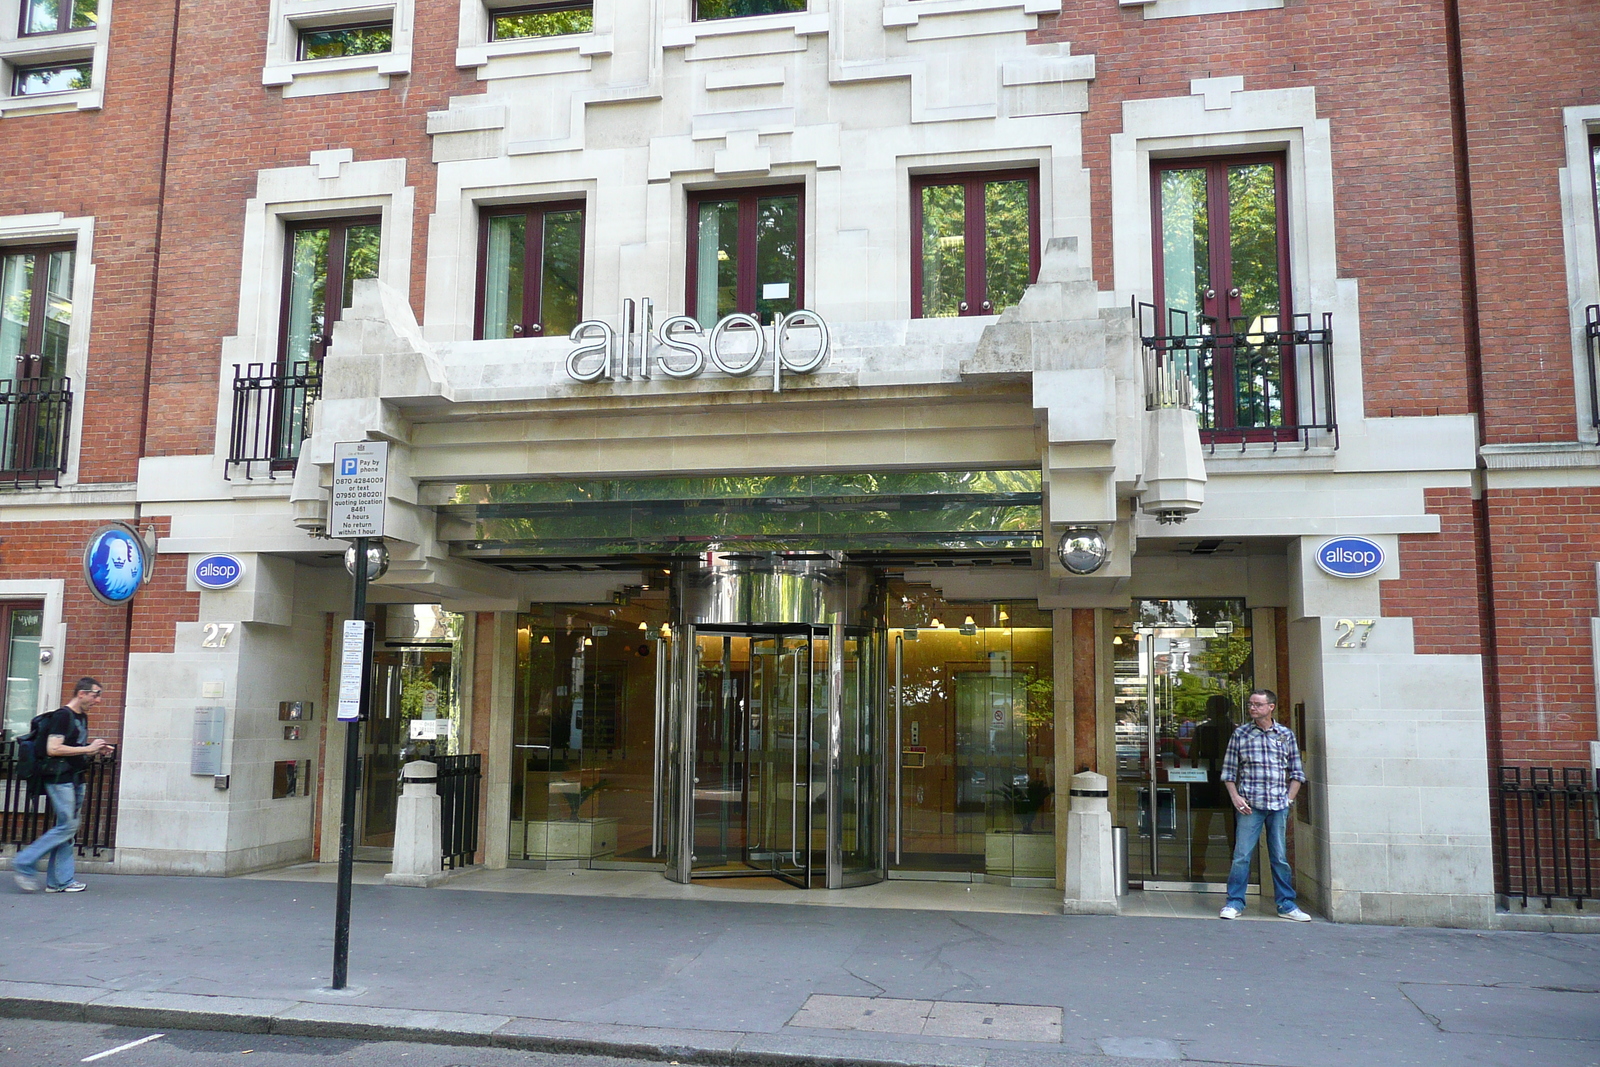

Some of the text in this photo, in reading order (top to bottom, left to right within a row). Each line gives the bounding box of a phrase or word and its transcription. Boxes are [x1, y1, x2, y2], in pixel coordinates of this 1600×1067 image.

[565, 296, 831, 393] allsop
[1326, 547, 1375, 566] allsop
[200, 563, 236, 579] allsop
[201, 622, 235, 648] 27
[1334, 618, 1376, 648] 27
